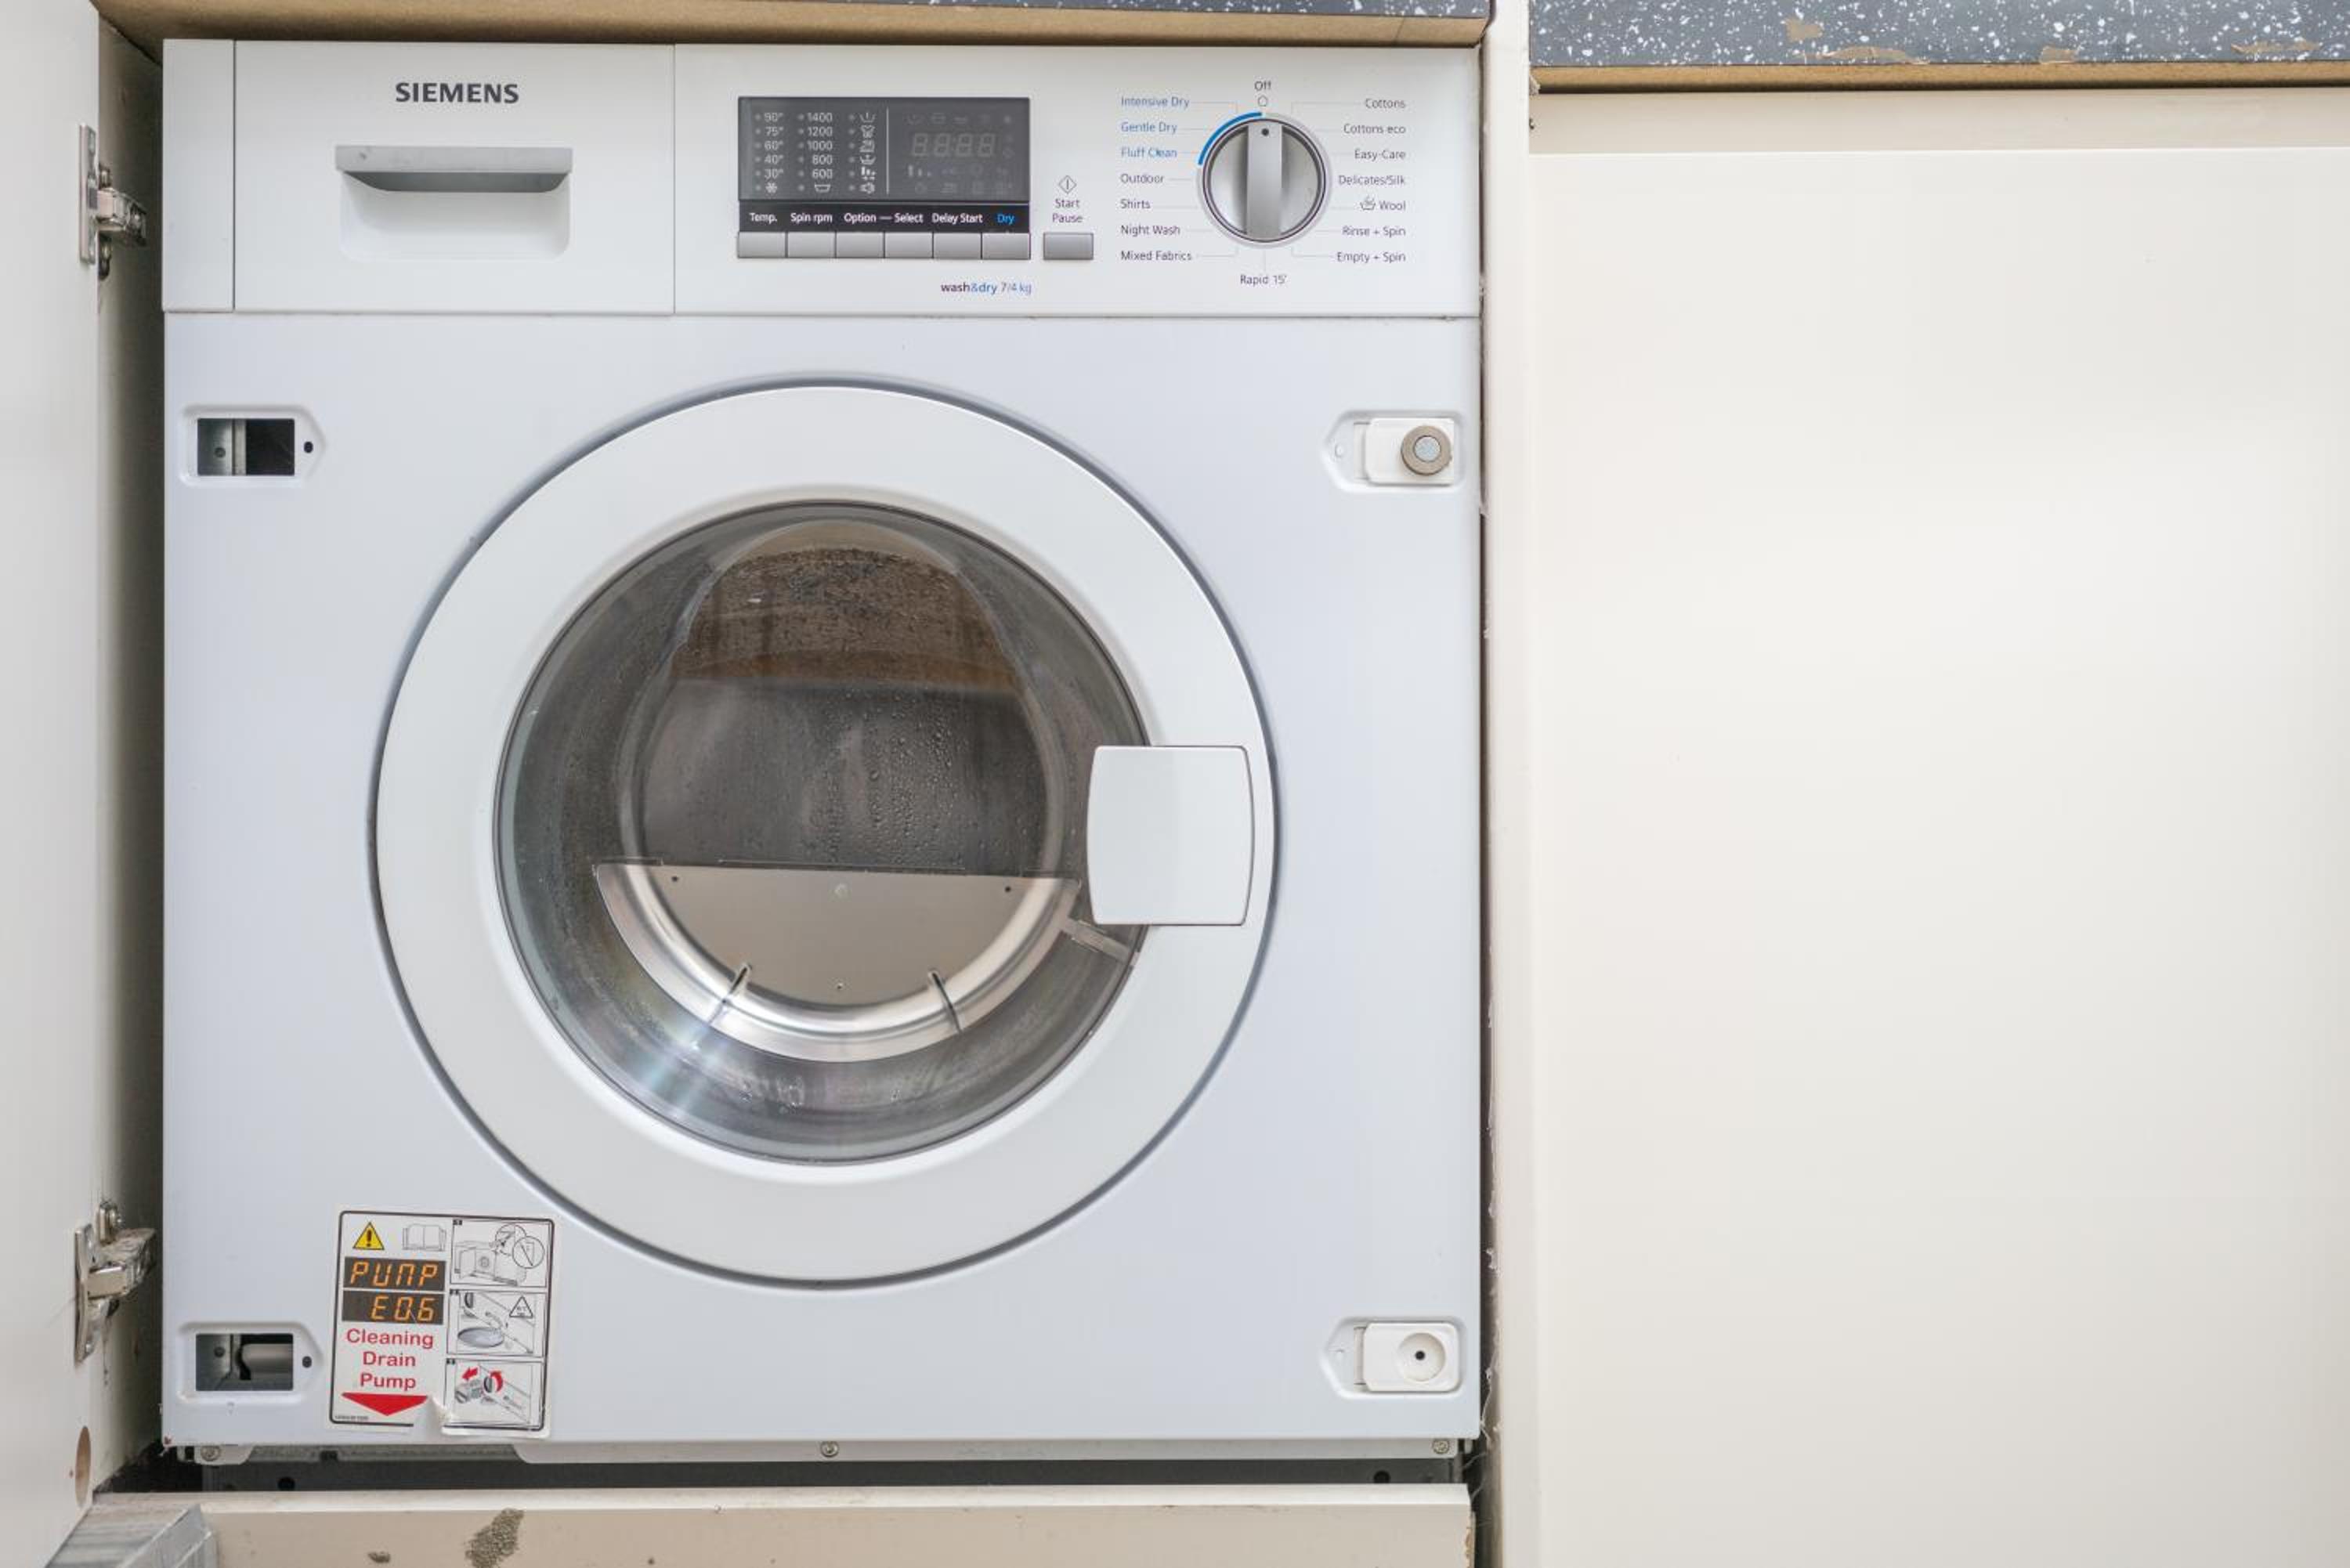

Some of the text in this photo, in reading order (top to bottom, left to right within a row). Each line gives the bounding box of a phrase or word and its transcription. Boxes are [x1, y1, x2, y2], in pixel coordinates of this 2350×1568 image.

[395, 81, 519, 104] SIEMENS
[1253, 80, 1272, 92] Off
[1121, 96, 1190, 109] Intensive Dry
[1365, 97, 1406, 109] Cottons
[807, 112, 833, 123] 1400
[807, 126, 833, 137] 1200
[1120, 121, 1177, 135] Gentle Dry
[1343, 122, 1407, 135] Cottons eco
[807, 140, 833, 151] 1000
[1120, 146, 1177, 159] Fluff Clean
[1354, 147, 1407, 161] Easy-Care
[812, 154, 833, 165] 800
[812, 168, 833, 179] 600
[1120, 172, 1165, 185] Outdoor
[1338, 174, 1406, 186] Delicates/Silk
[1054, 197, 1080, 209] Start
[1120, 198, 1152, 211] Shirts
[1379, 200, 1407, 212] Wool
[749, 211, 779, 225] Temp.
[790, 211, 833, 225] Spin rpm
[843, 211, 924, 225] Option Select
[931, 212, 984, 226] Delay Start
[996, 212, 1016, 226] Dry
[1051, 212, 1084, 225] Pause
[1120, 224, 1181, 238] Night Wash
[1342, 225, 1370, 237] Rinse
[1383, 225, 1407, 239] Spin
[1120, 250, 1193, 262] Mixed Fabrics
[1336, 251, 1370, 265] Empty
[1383, 251, 1407, 265] Spin
[940, 280, 1033, 295] wash&dry 7/4 kg
[1239, 274, 1270, 288] Rapid
[345, 1327, 435, 1350] Cleaning
[362, 1350, 417, 1367] Drain
[360, 1372, 417, 1392] Pump
